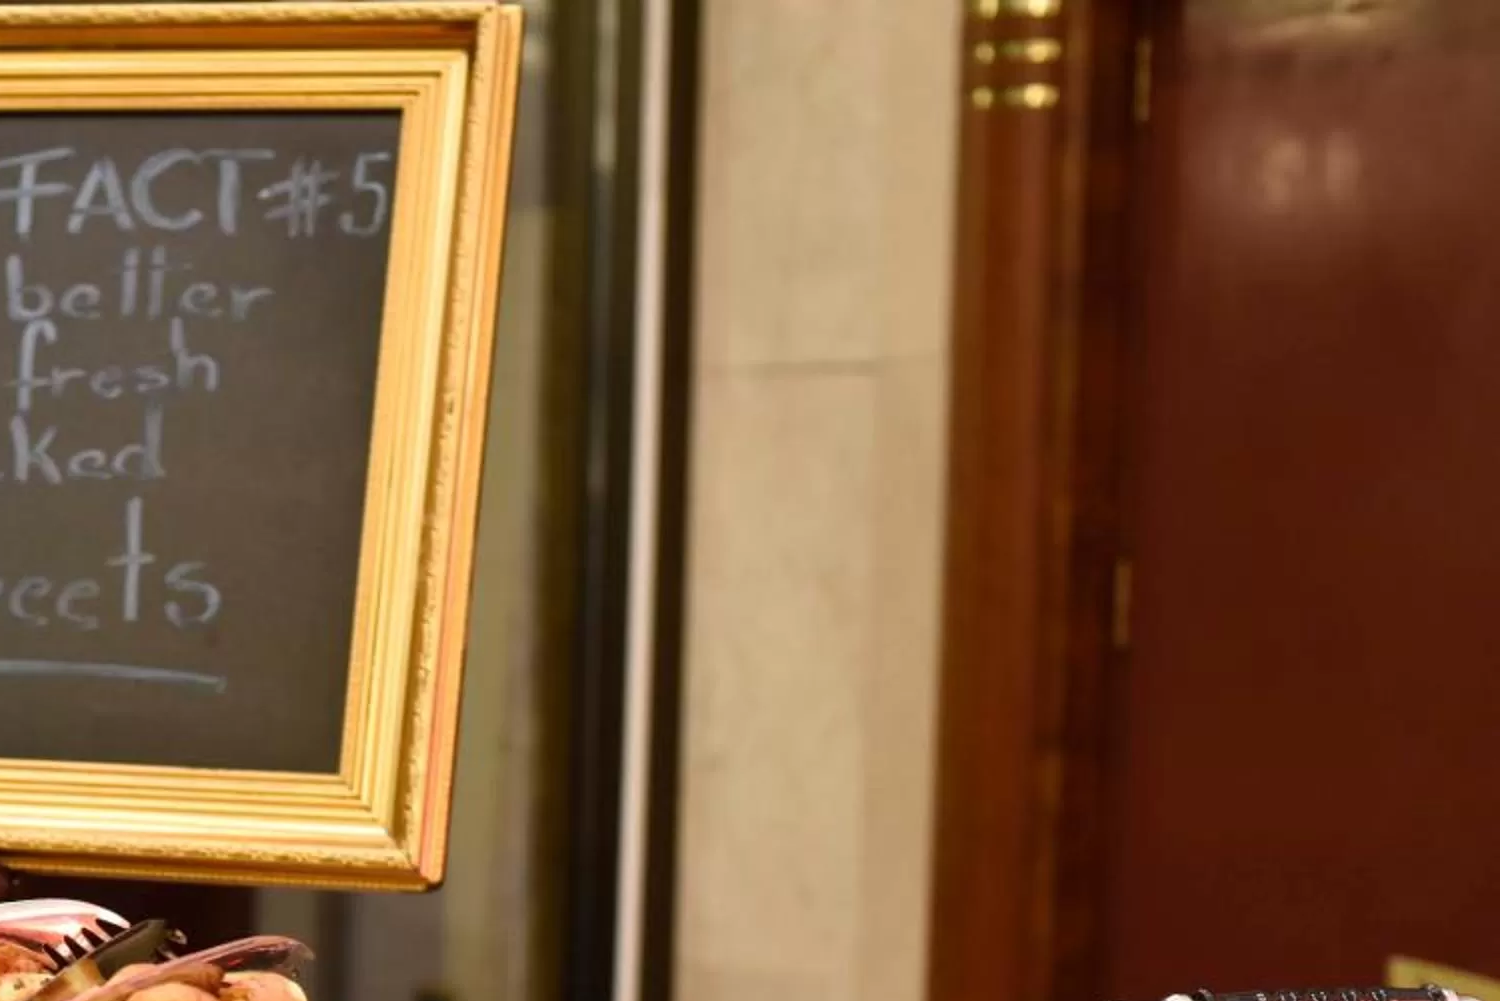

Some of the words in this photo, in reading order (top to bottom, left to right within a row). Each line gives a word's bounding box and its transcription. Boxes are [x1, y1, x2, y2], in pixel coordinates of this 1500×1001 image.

[258, 151, 391, 237] #5
[5, 246, 275, 322] better
[4, 317, 219, 410] fresh
